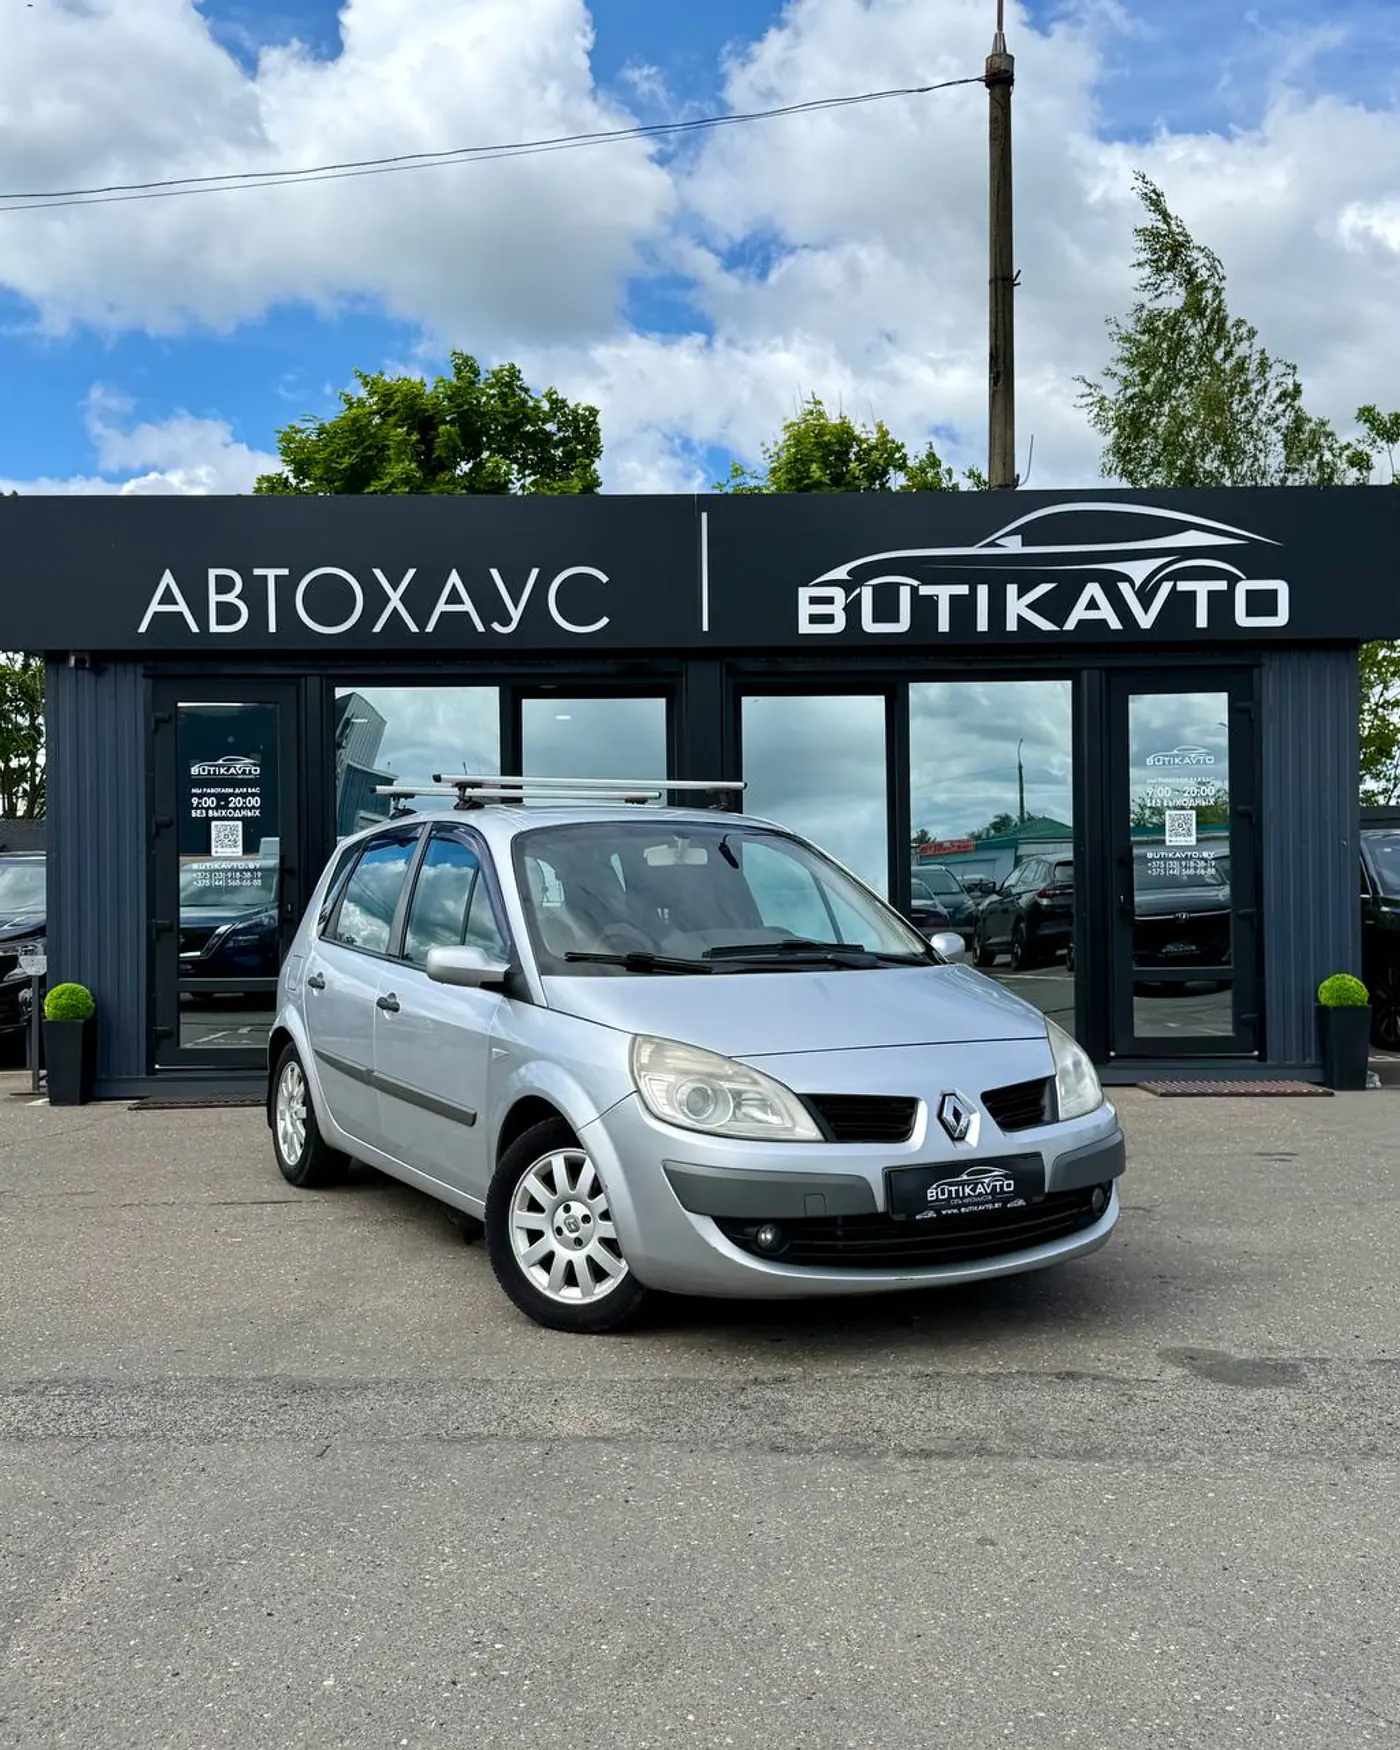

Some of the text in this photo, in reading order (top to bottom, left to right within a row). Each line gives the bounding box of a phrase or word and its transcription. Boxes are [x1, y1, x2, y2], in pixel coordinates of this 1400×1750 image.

[138, 566, 610, 634] АВТОХАУС
[797, 579, 1290, 634] BUTIKAVTO
[1146, 756, 1215, 766] BUTIKAVTO
[191, 766, 260, 775] BUTIKAVTO
[1147, 787, 1172, 798] 9:00
[1183, 786, 1216, 797] 20:00
[191, 797, 216, 808] 9:00
[228, 796, 261, 807] 20:00
[191, 809, 261, 818] БЕЗ ВЫХОДНЫХ
[1147, 851, 1215, 859] BUTIKAVTO.BY
[927, 1180, 1015, 1201] BUTIKAVTO
